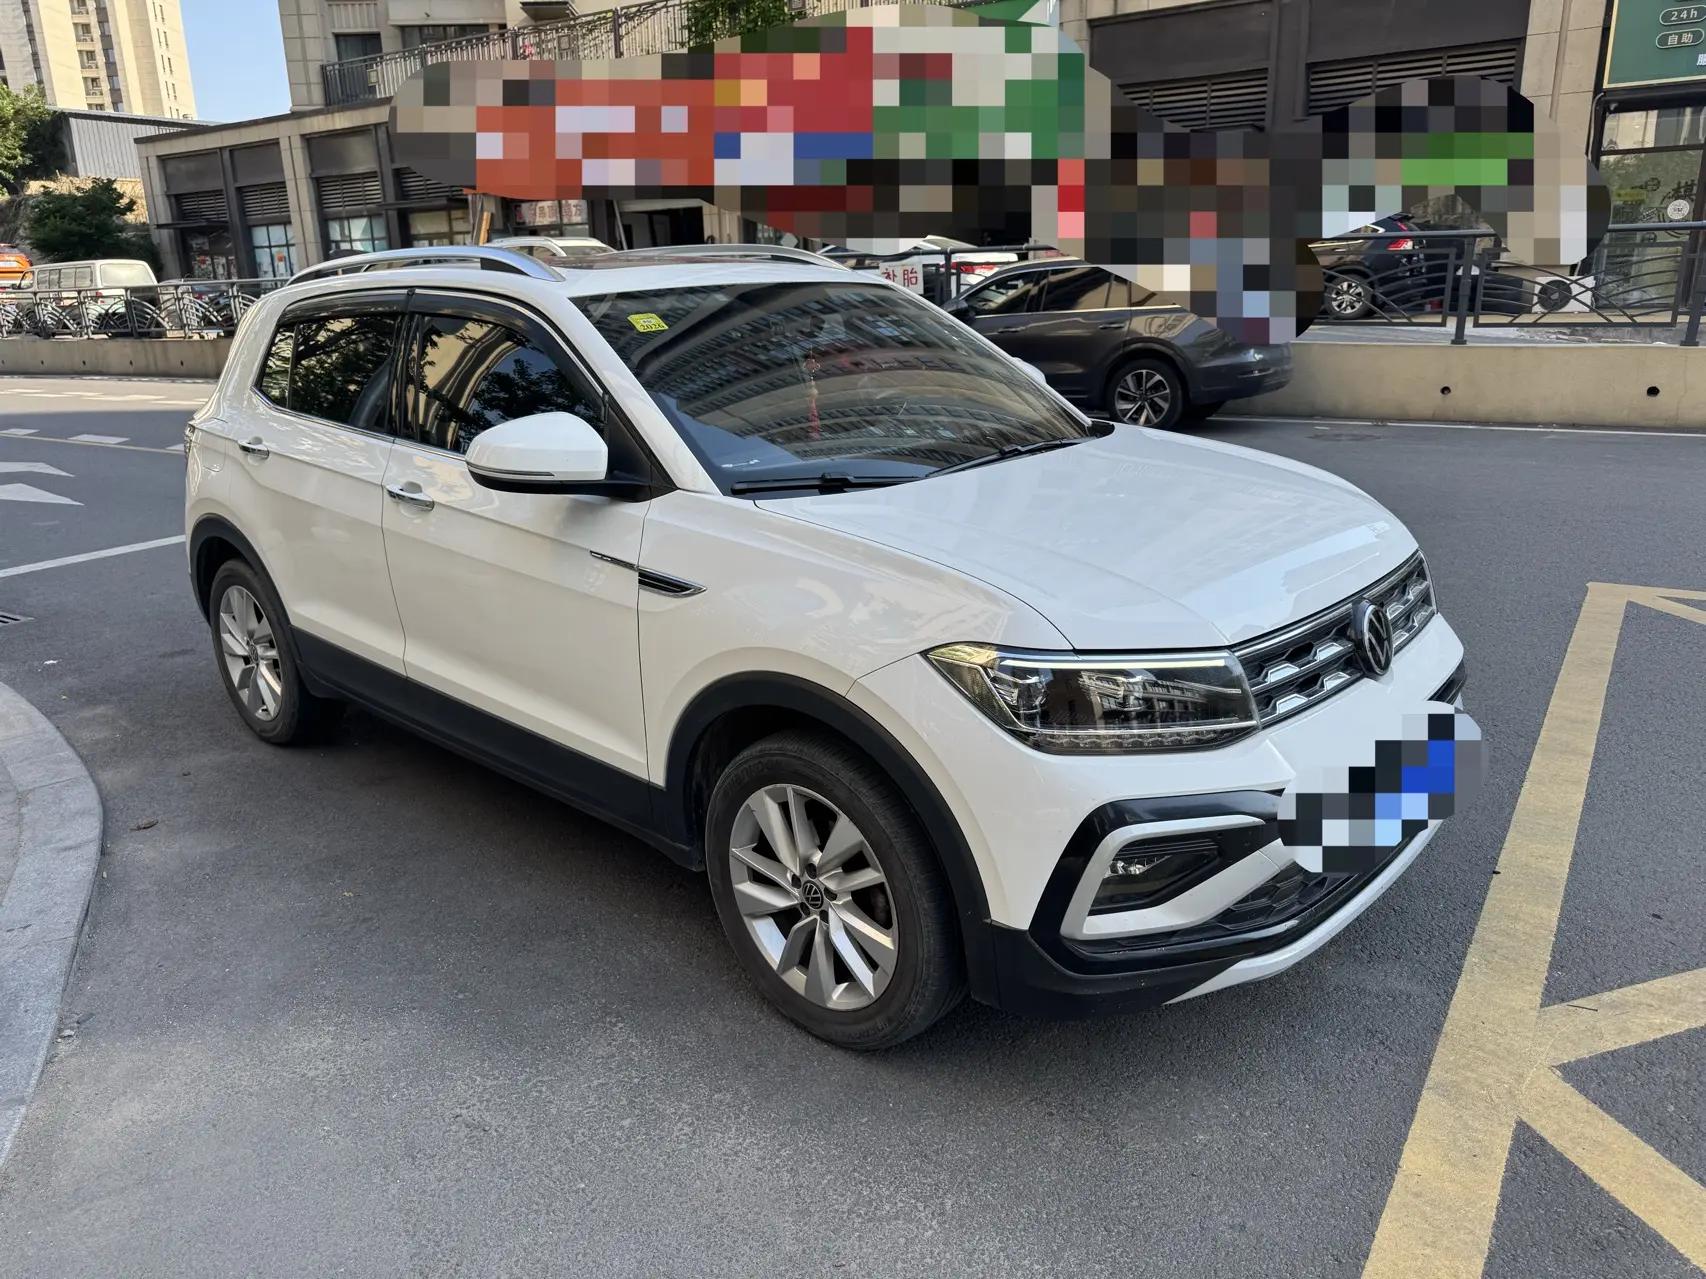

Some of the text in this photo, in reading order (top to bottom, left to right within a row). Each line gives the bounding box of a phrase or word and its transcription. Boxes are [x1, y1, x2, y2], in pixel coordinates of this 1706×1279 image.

[1670, 8, 1698, 21] 24h
[1667, 32, 1693, 46] 自助
[882, 267, 918, 287] 补胎
